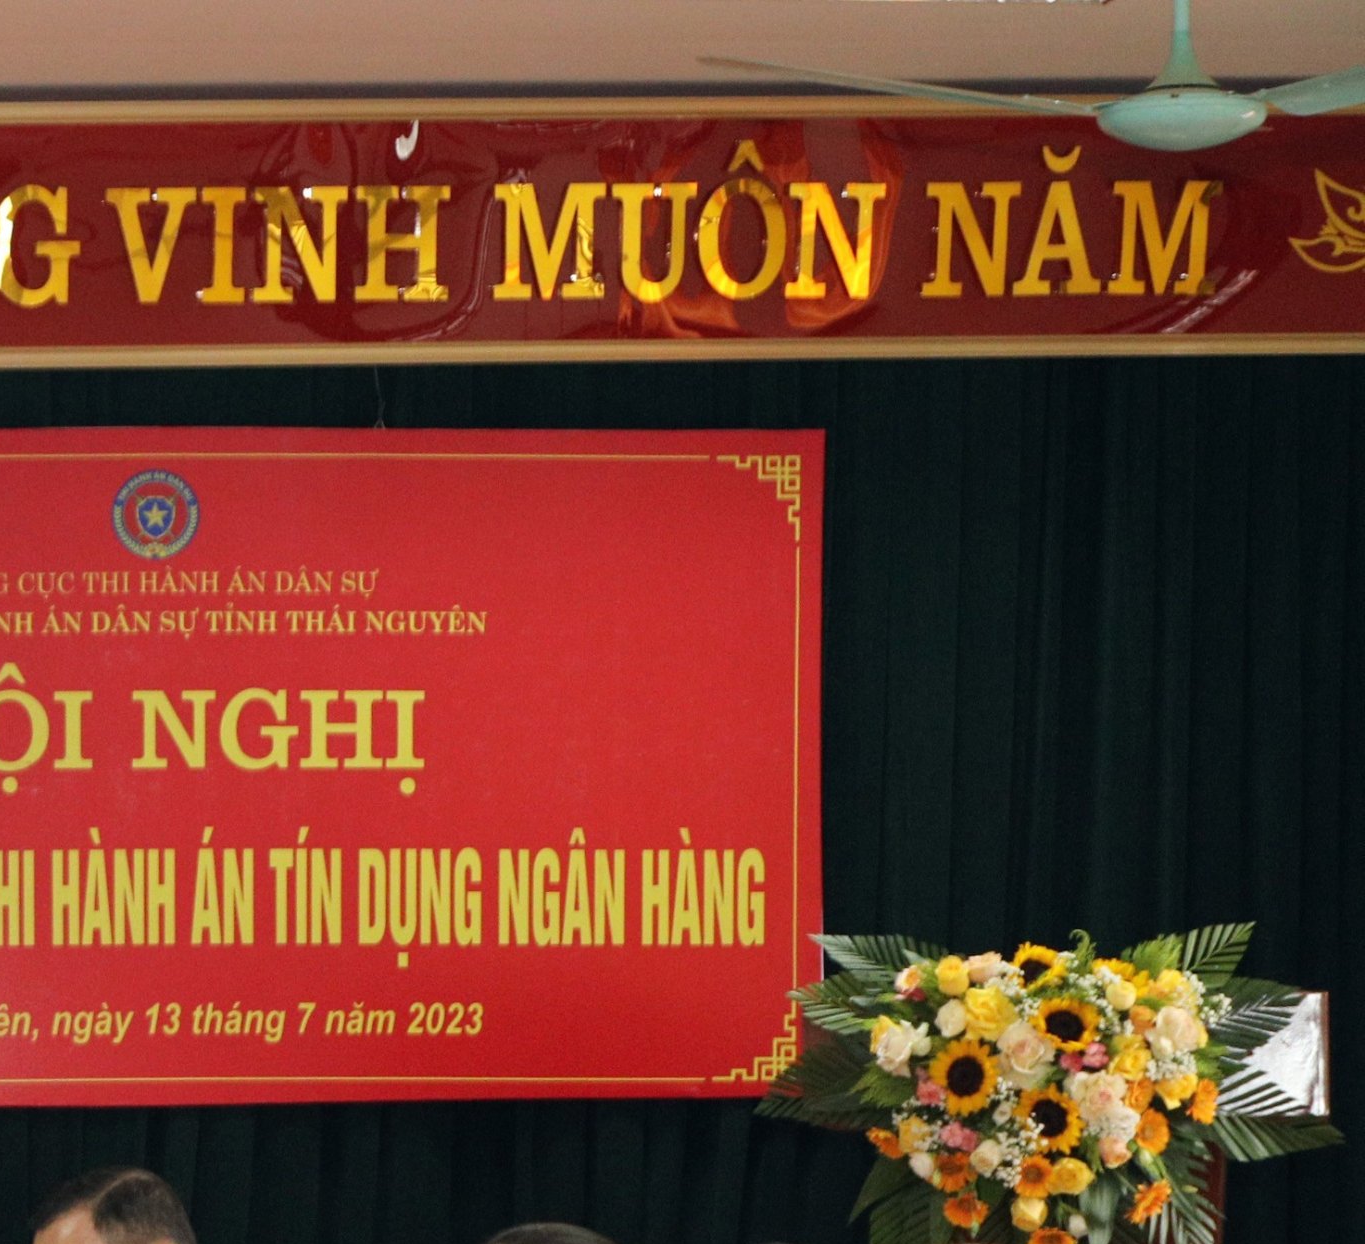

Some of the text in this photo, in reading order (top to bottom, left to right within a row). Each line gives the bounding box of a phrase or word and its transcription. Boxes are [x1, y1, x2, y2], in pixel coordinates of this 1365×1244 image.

[105, 184, 453, 305] VINH
[493, 140, 889, 303] MUÔN
[921, 144, 1226, 299] NĂM
[18, 572, 75, 600] CỤC
[82, 571, 130, 594] THI
[139, 565, 220, 594] HÀNH
[226, 564, 269, 594] ÁN
[274, 565, 332, 594] DÂN
[340, 567, 379, 598] SỰ
[41, 605, 81, 635] ÁN
[91, 605, 151, 635] DÂN
[159, 608, 199, 640] SỰ
[206, 601, 278, 635] TỈNH
[286, 605, 356, 635] THÁI
[365, 605, 488, 635] NGUYÊN
[132, 687, 427, 797] NGHỊ
[51, 826, 178, 947] HÀNH
[191, 826, 257, 947] ÁN
[269, 826, 345, 946] TÍN
[357, 847, 485, 970] DỤNG
[498, 826, 629, 948] NGÂN
[642, 827, 769, 949] HÀNG
[51, 1008, 136, 1047] ngày
[144, 1003, 183, 1036] 13
[193, 1003, 289, 1046] tháng
[299, 1002, 319, 1035] 7
[325, 1003, 399, 1036] năm
[408, 1003, 486, 1037] 2023
